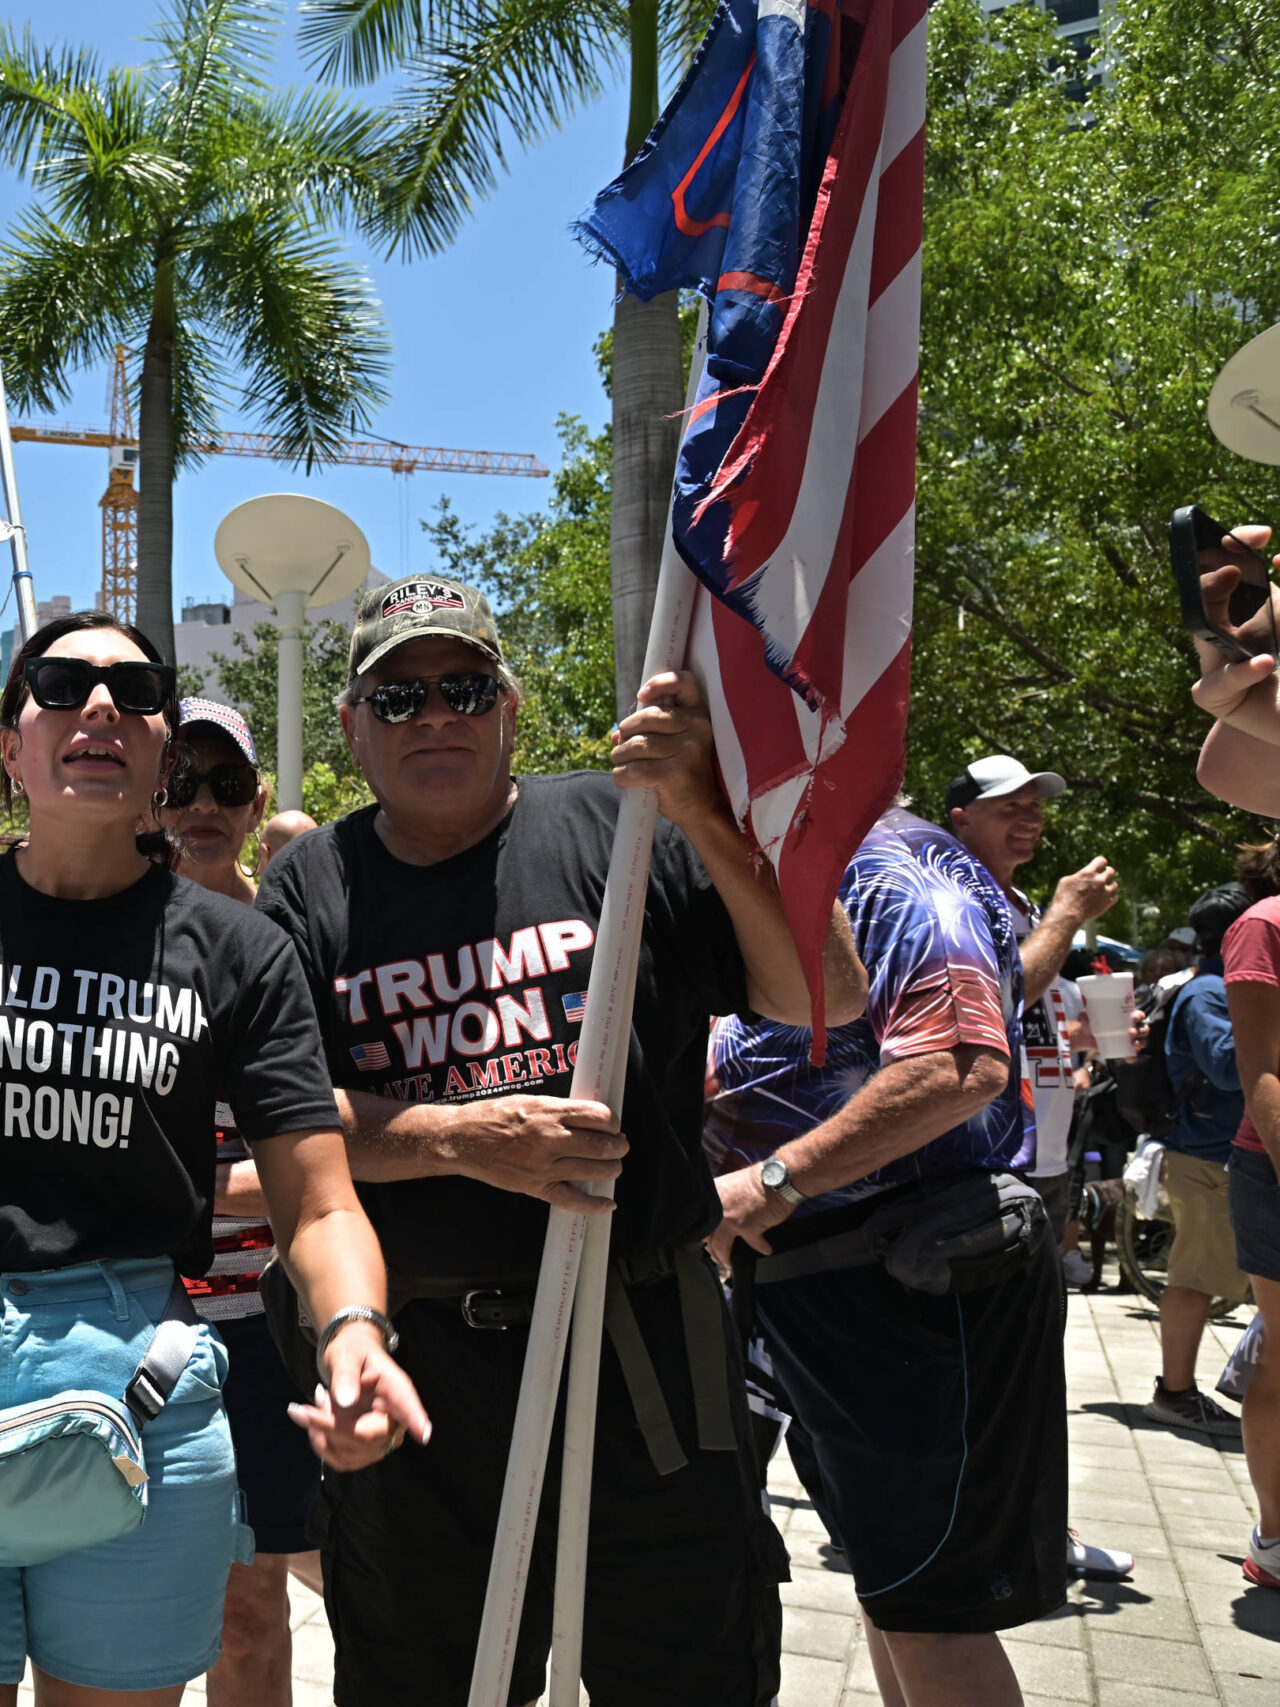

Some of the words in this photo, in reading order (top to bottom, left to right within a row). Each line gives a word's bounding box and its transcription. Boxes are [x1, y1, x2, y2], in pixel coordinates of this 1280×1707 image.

[390, 584, 453, 604] RILEY'S
[334, 919, 594, 1025] TRUMP
[391, 987, 552, 1071] WON
[375, 1074, 434, 1101] AVE
